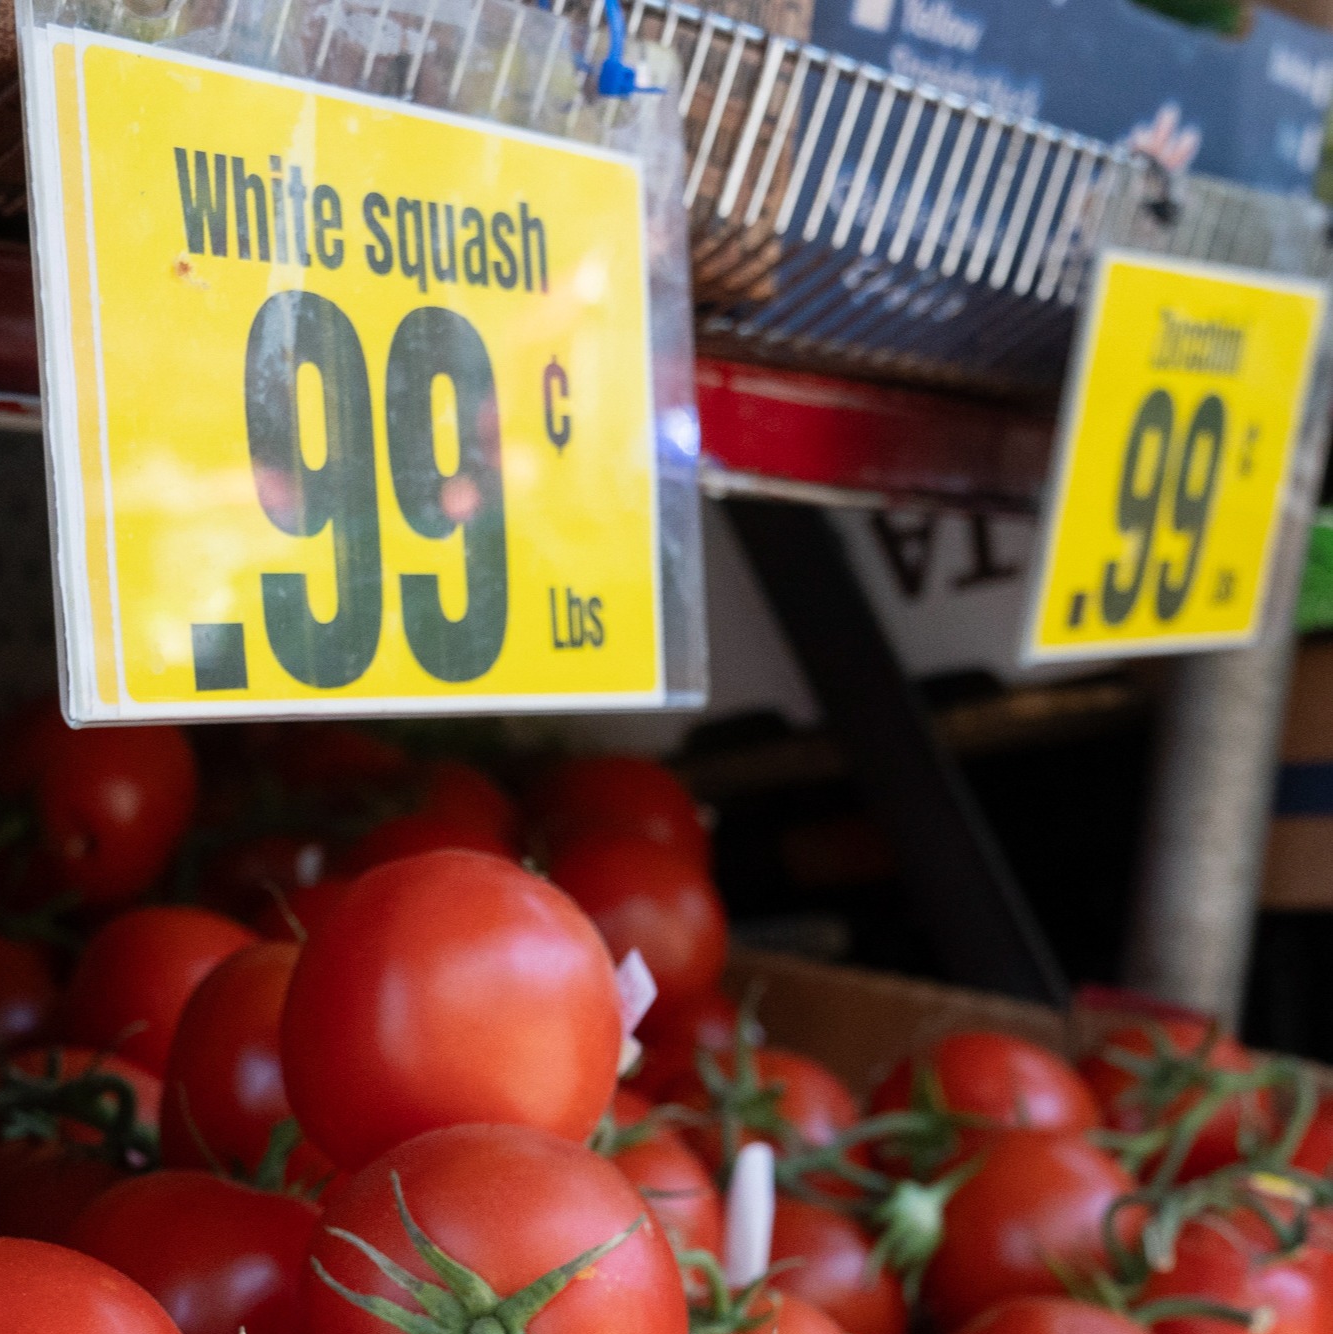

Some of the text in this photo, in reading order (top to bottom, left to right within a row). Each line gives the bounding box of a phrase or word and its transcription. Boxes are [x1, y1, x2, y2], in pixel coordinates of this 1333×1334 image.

[173, 147, 549, 294] White squash
[190, 290, 509, 691] .99
[1067, 388, 1226, 629] .99
[548, 586, 604, 650] Lbs
